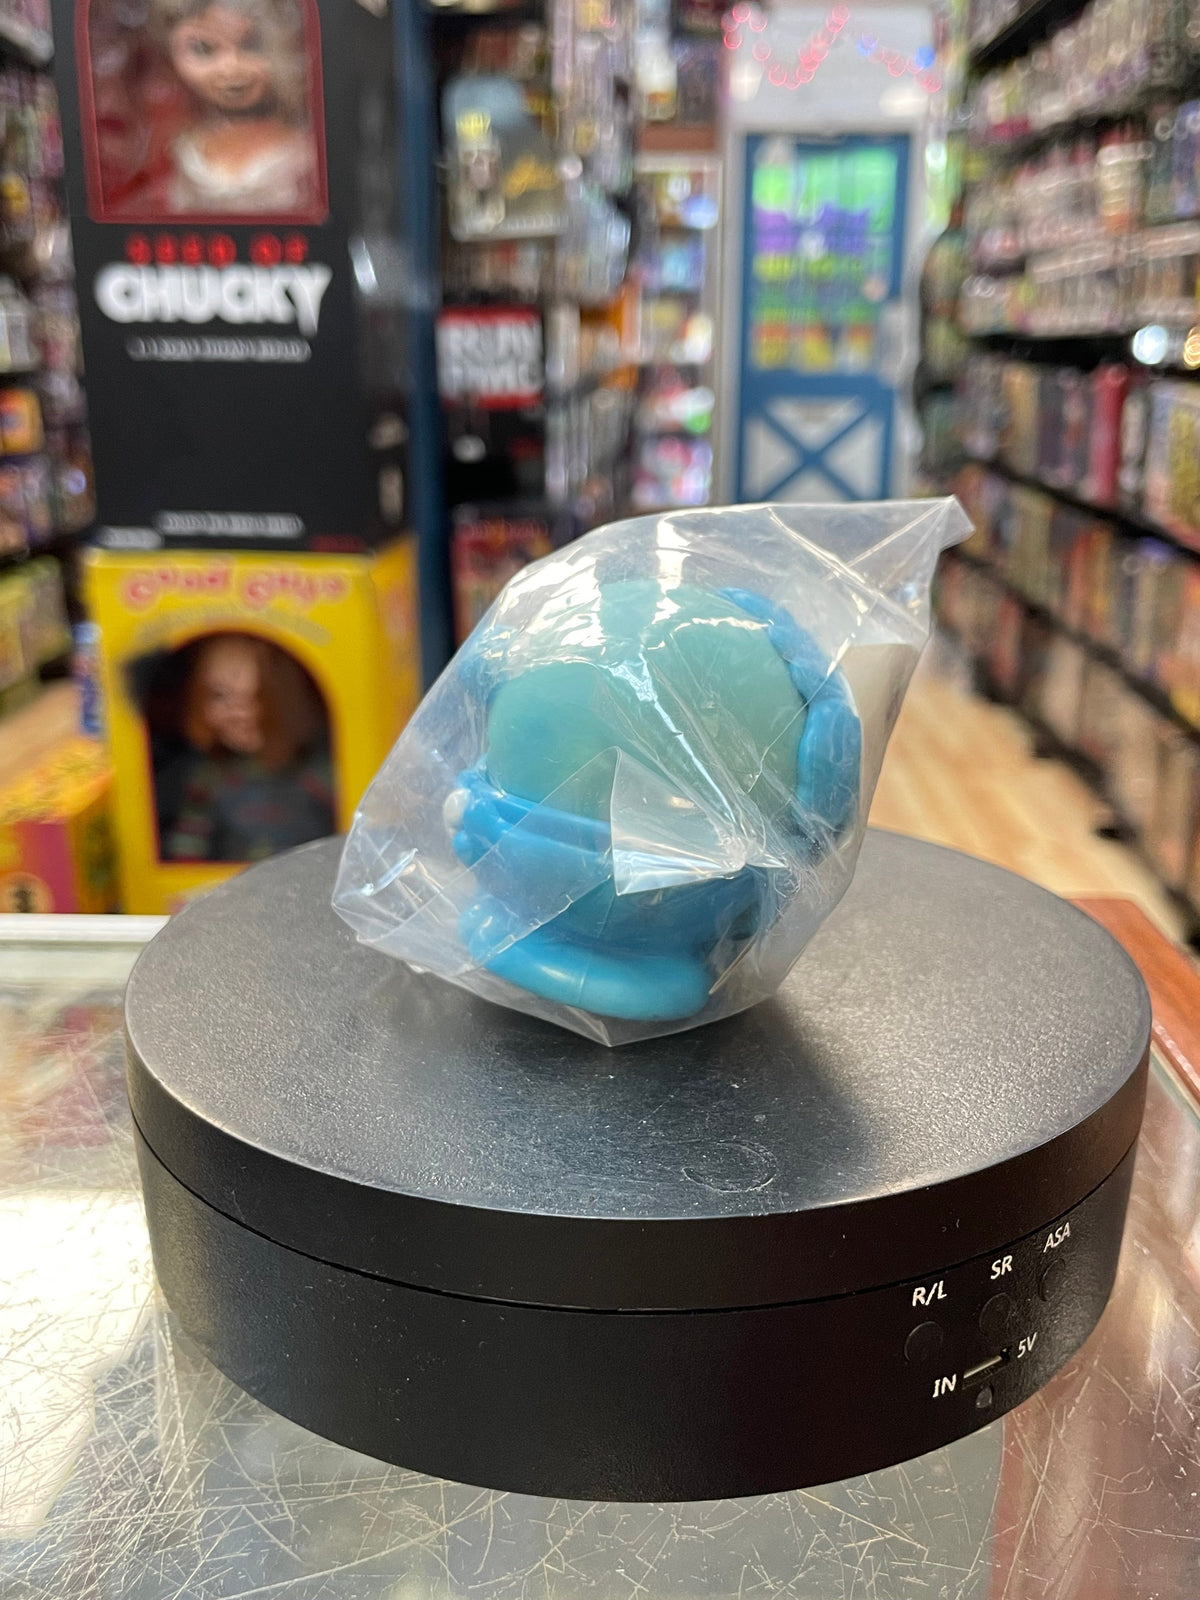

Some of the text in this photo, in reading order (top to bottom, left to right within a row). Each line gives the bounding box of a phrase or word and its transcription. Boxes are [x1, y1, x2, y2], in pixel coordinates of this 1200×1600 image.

[95, 263, 332, 337] CHUCKY
[912, 1222, 1071, 1306] R/L SR ASA
[932, 1332, 1038, 1398] IN 5V
